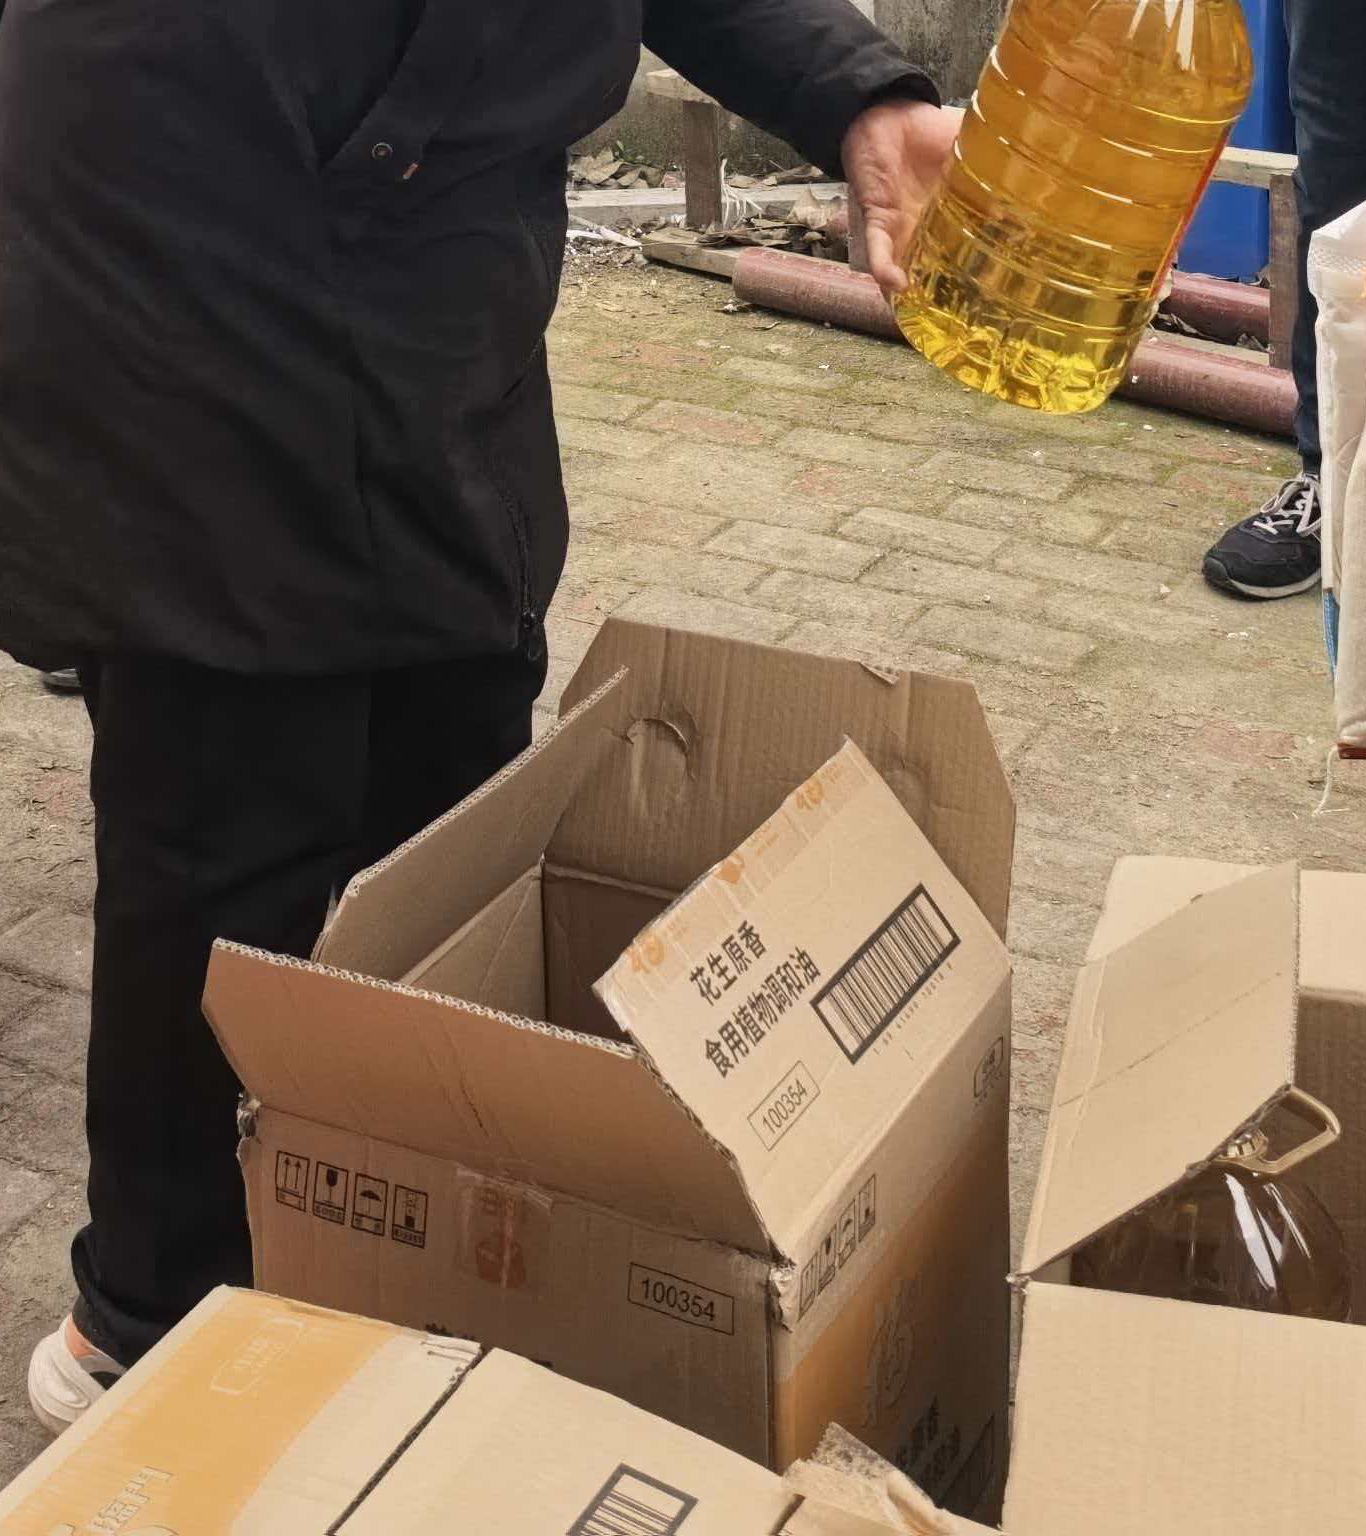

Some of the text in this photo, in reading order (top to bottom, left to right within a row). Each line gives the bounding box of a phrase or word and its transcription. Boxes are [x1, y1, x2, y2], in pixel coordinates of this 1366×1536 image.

[690, 920, 766, 1006] 花生原香
[705, 946, 821, 1078] 食用植物调和油
[762, 1079, 808, 1134] 100354
[641, 1276, 716, 1322] 100354
